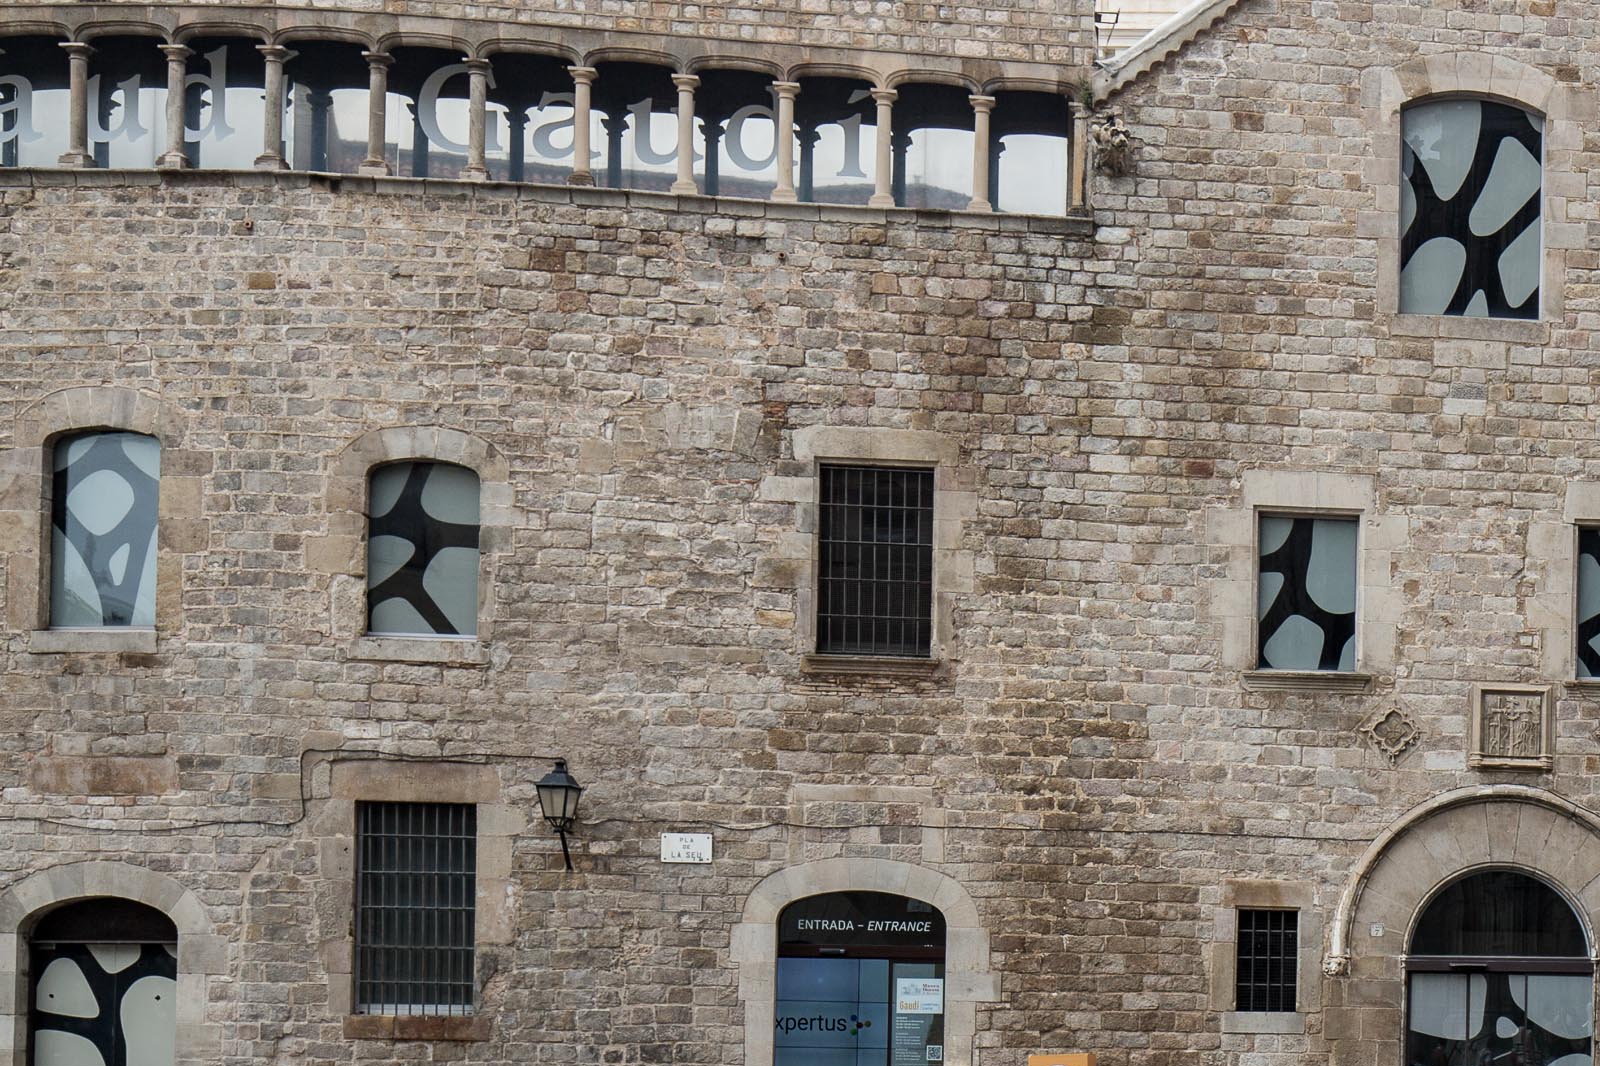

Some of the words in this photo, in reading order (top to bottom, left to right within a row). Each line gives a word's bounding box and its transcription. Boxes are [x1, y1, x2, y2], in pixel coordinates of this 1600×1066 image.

[671, 851, 682, 859] LA
[798, 919, 854, 930] ENTRADA
[867, 920, 932, 932] ENTRANCE
